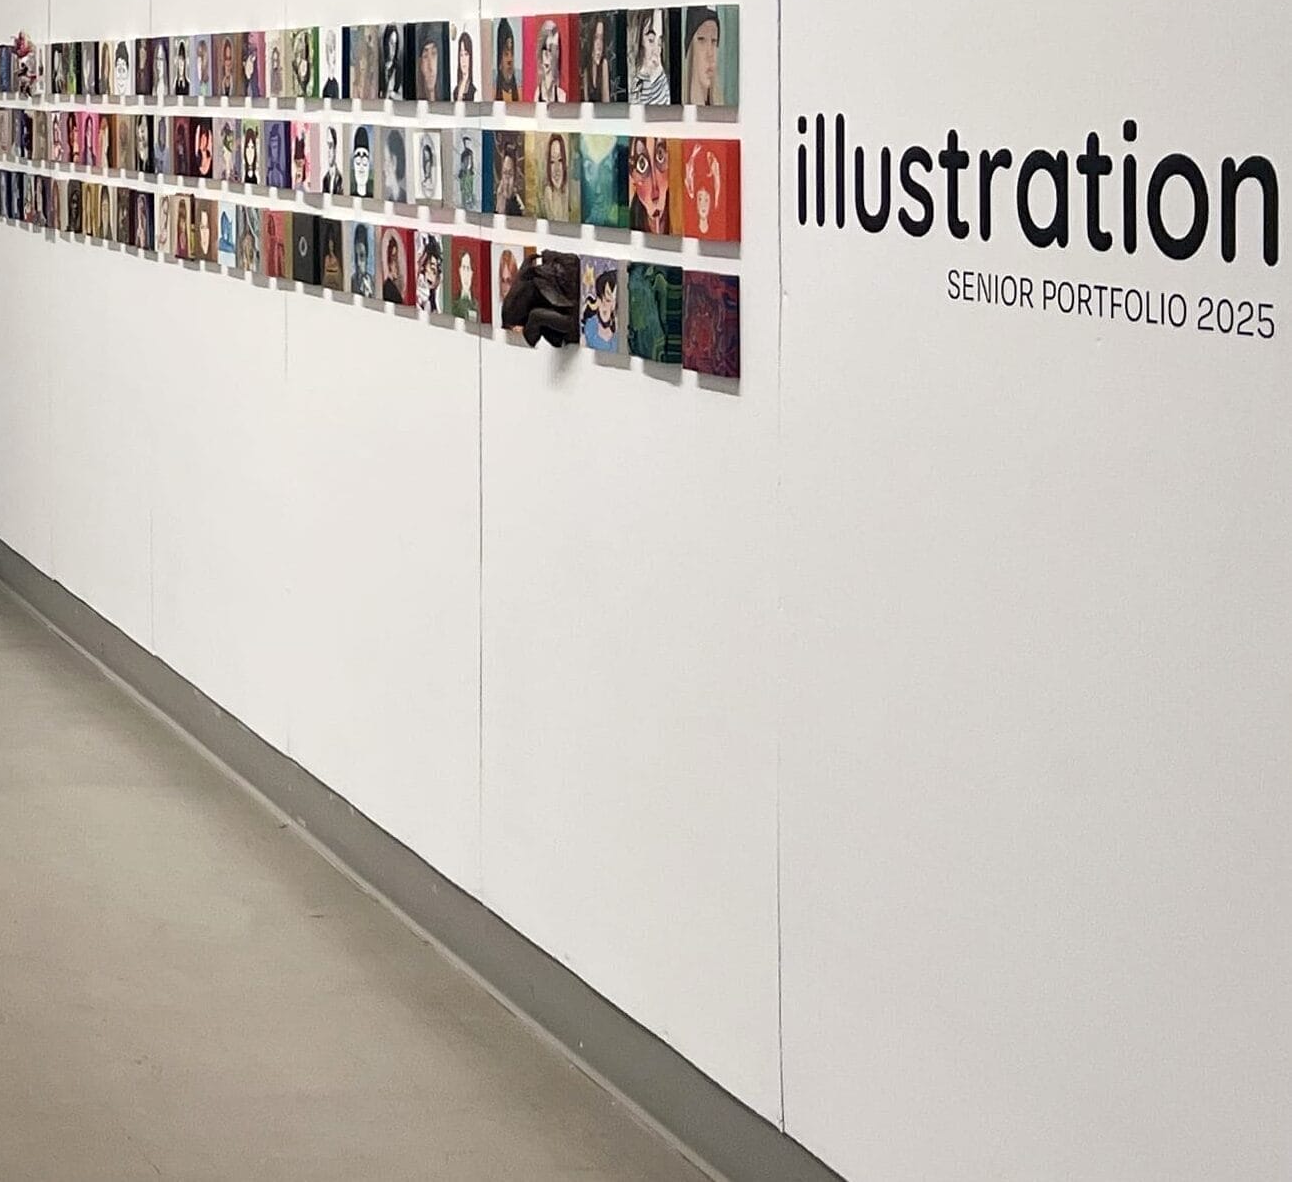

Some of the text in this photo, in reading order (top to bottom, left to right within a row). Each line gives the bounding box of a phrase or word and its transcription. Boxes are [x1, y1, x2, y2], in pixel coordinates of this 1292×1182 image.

[797, 113, 1279, 267] illustration
[947, 269, 1276, 339] SENIOR PORTFOLIO 2025
